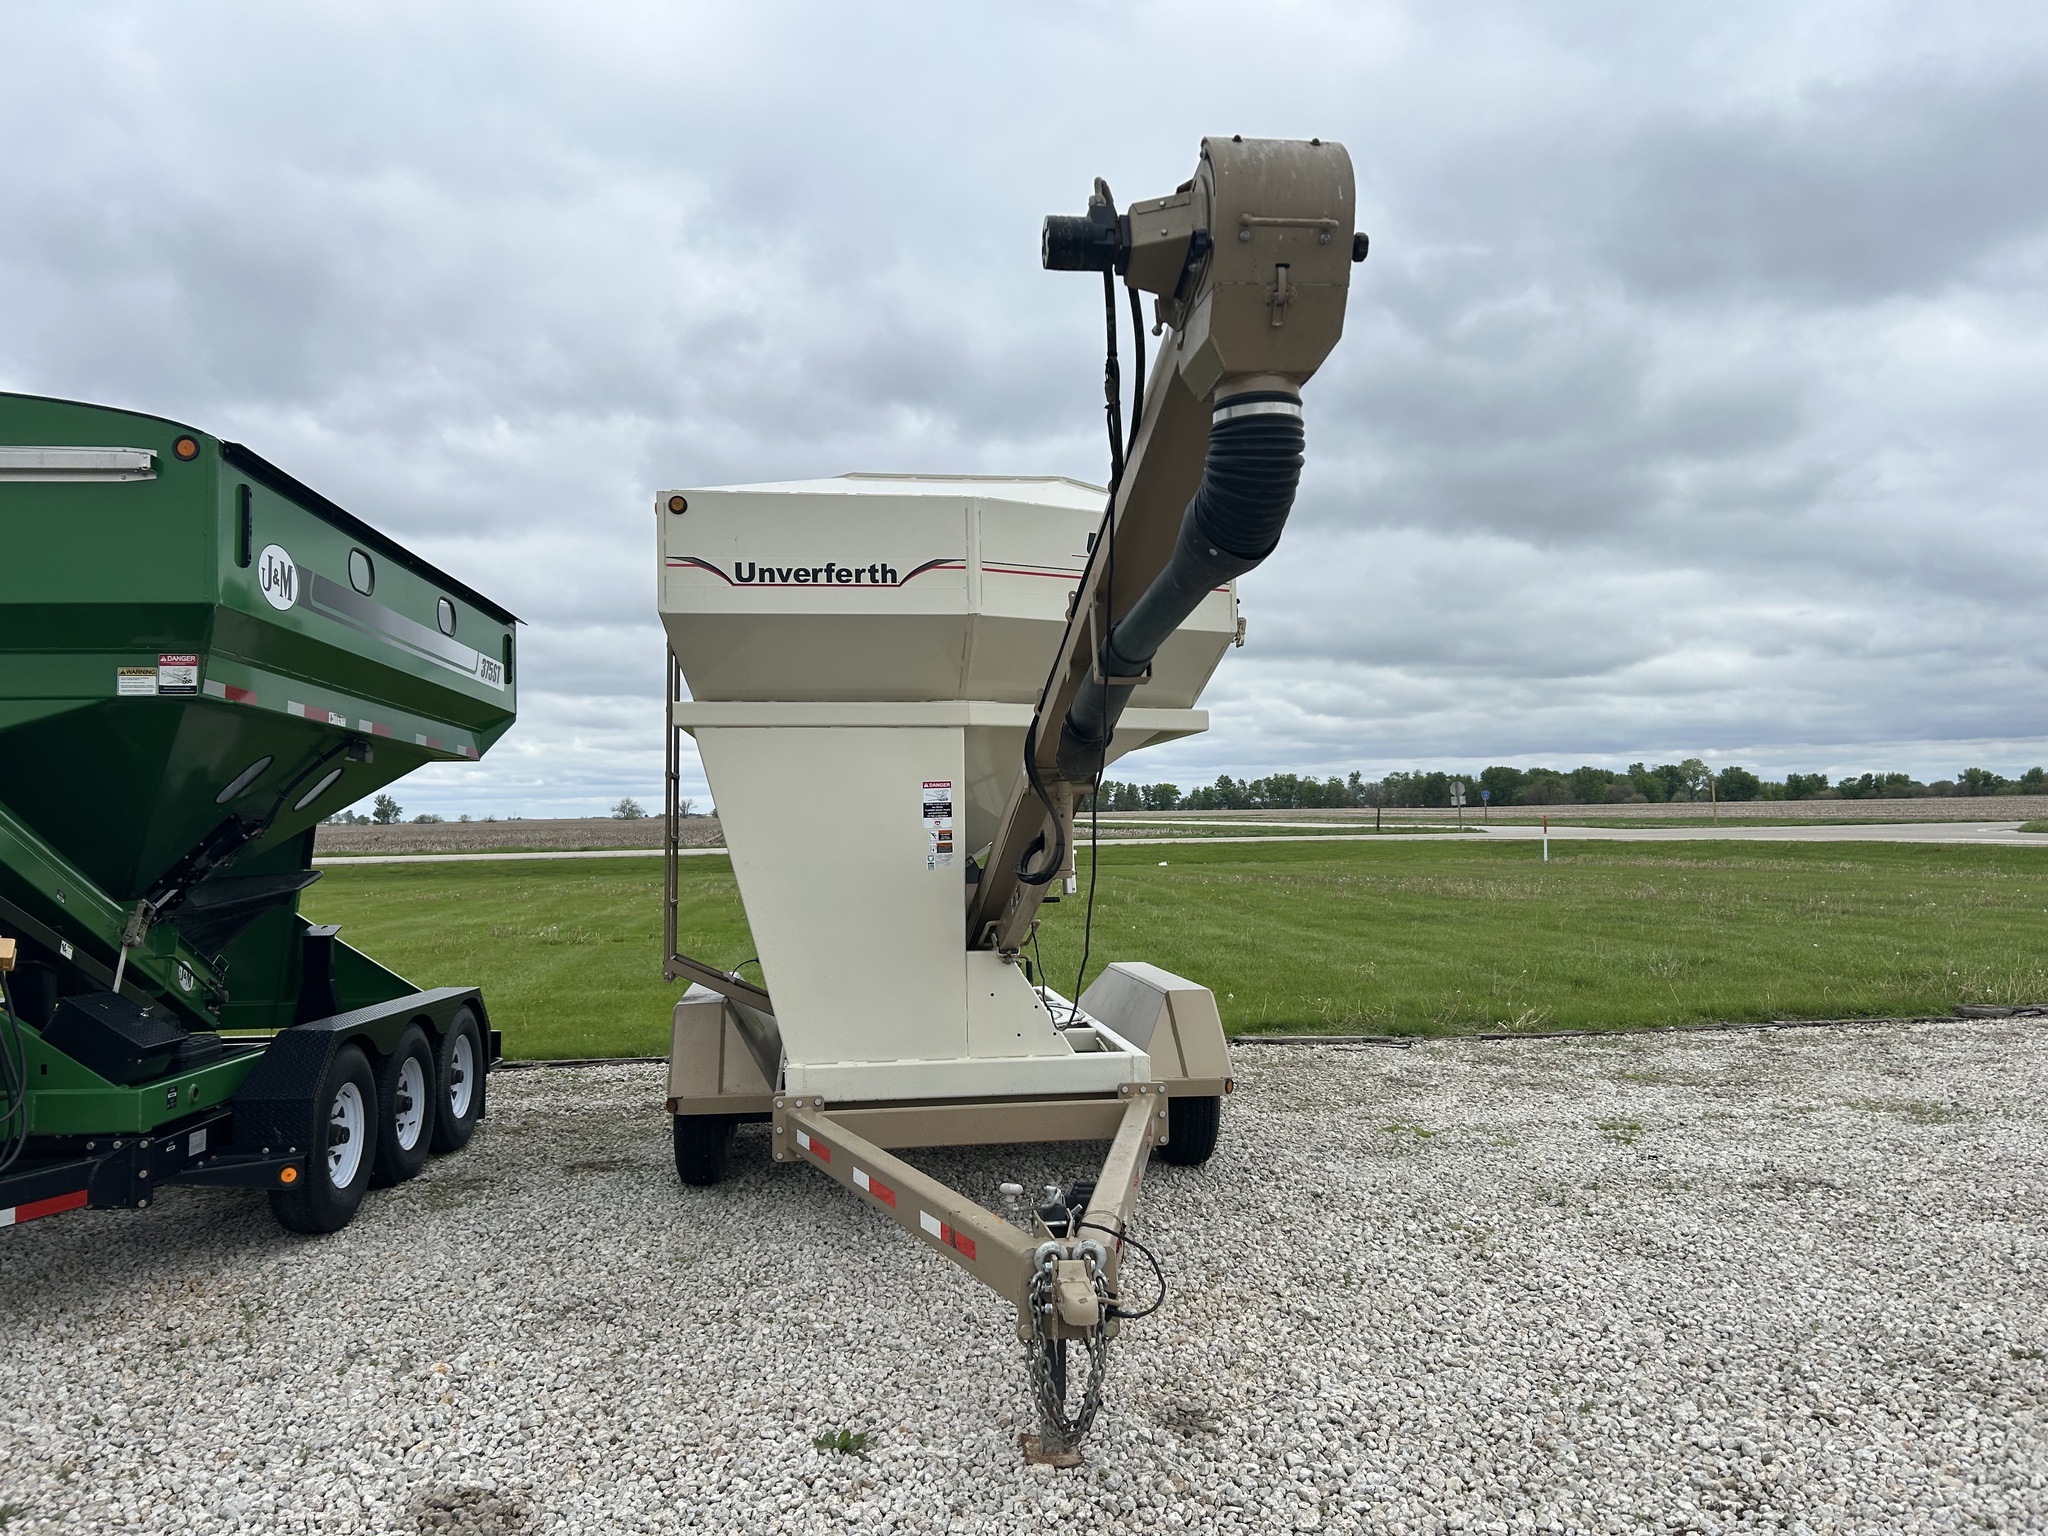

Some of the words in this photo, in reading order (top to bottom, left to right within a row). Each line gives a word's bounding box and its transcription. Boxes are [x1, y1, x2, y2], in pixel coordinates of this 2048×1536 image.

[261, 554, 293, 602] J&M
[734, 561, 898, 584] Unverferth
[480, 658, 501, 684] 375ST
